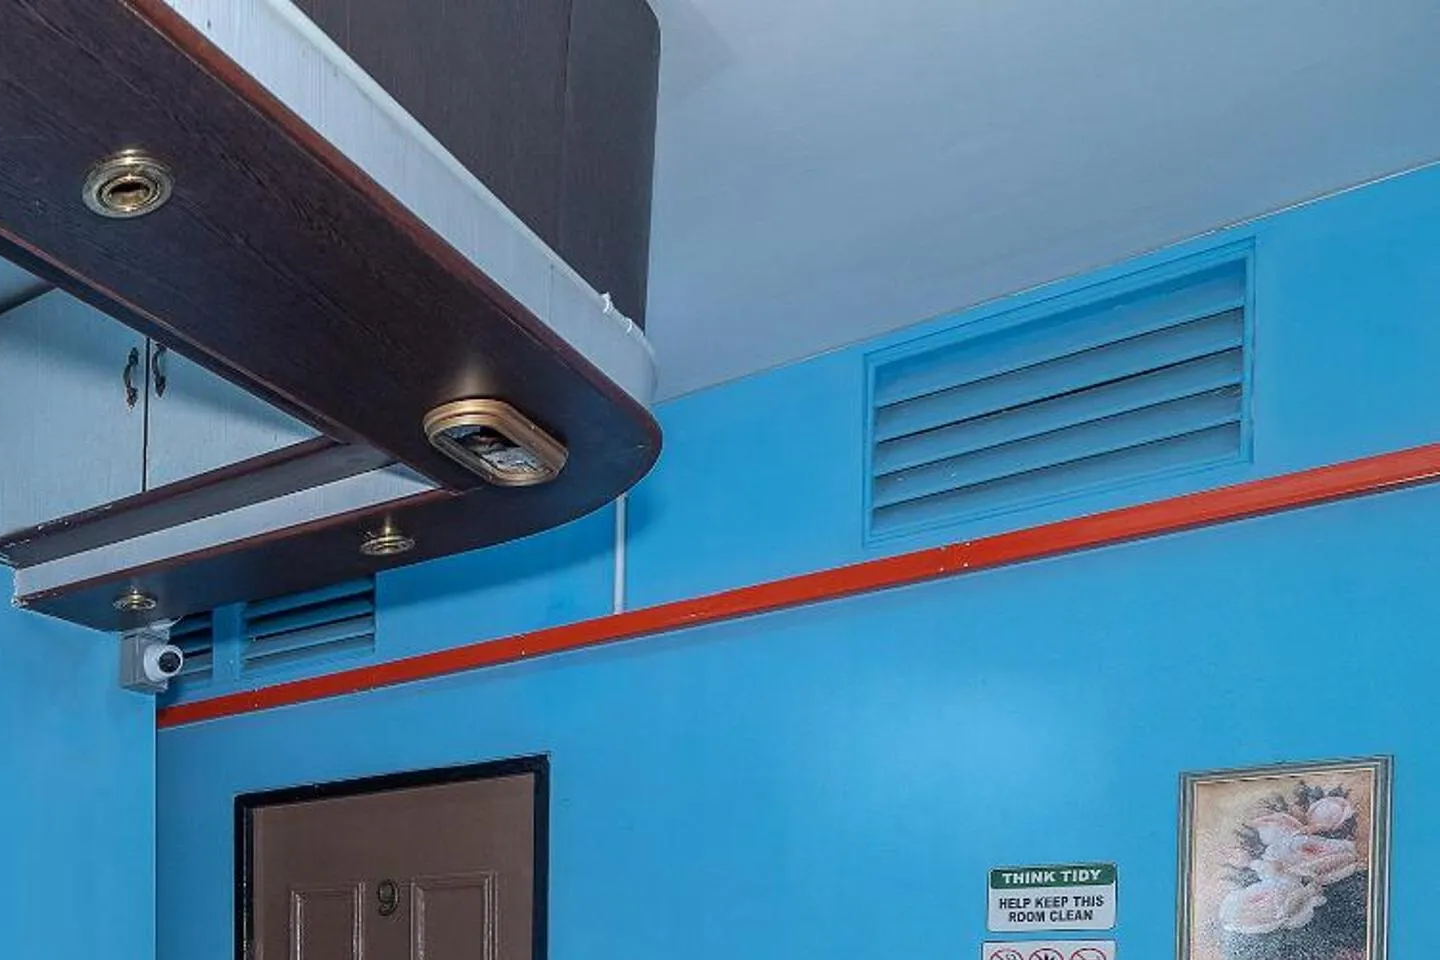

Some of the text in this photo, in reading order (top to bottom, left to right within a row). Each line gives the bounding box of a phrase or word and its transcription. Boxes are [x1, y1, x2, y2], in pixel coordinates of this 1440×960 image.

[1002, 869, 1102, 884] THINK TIDY
[376, 879, 401, 917] 9
[999, 894, 1105, 909] HELP KEEP THIS
[1009, 910, 1094, 922] ROOM CLEAN
